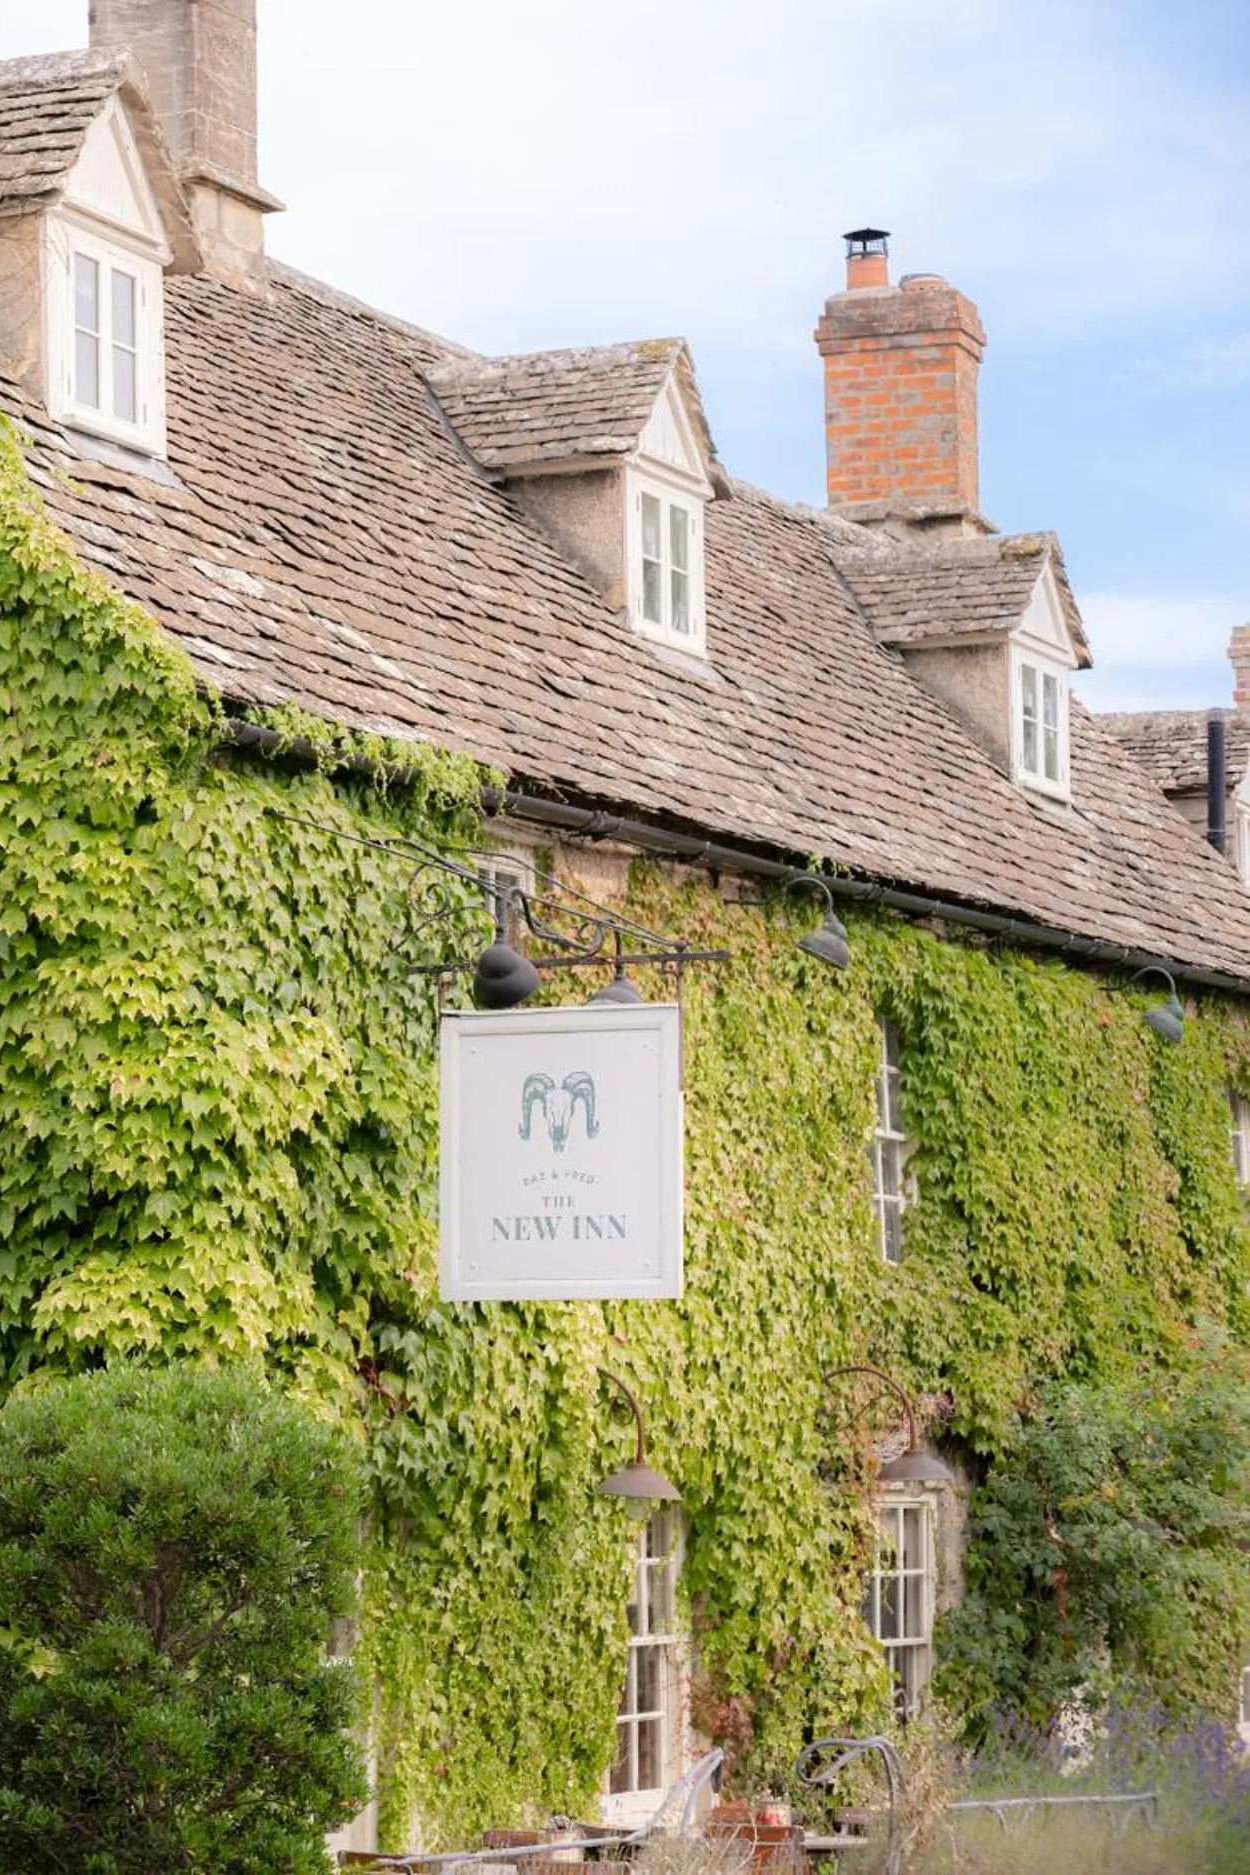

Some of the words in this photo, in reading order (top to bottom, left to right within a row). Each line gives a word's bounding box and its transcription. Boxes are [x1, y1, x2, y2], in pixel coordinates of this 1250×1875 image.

[541, 1195, 576, 1209] THE
[492, 1216, 562, 1241] NEW
[572, 1214, 627, 1240] INN
